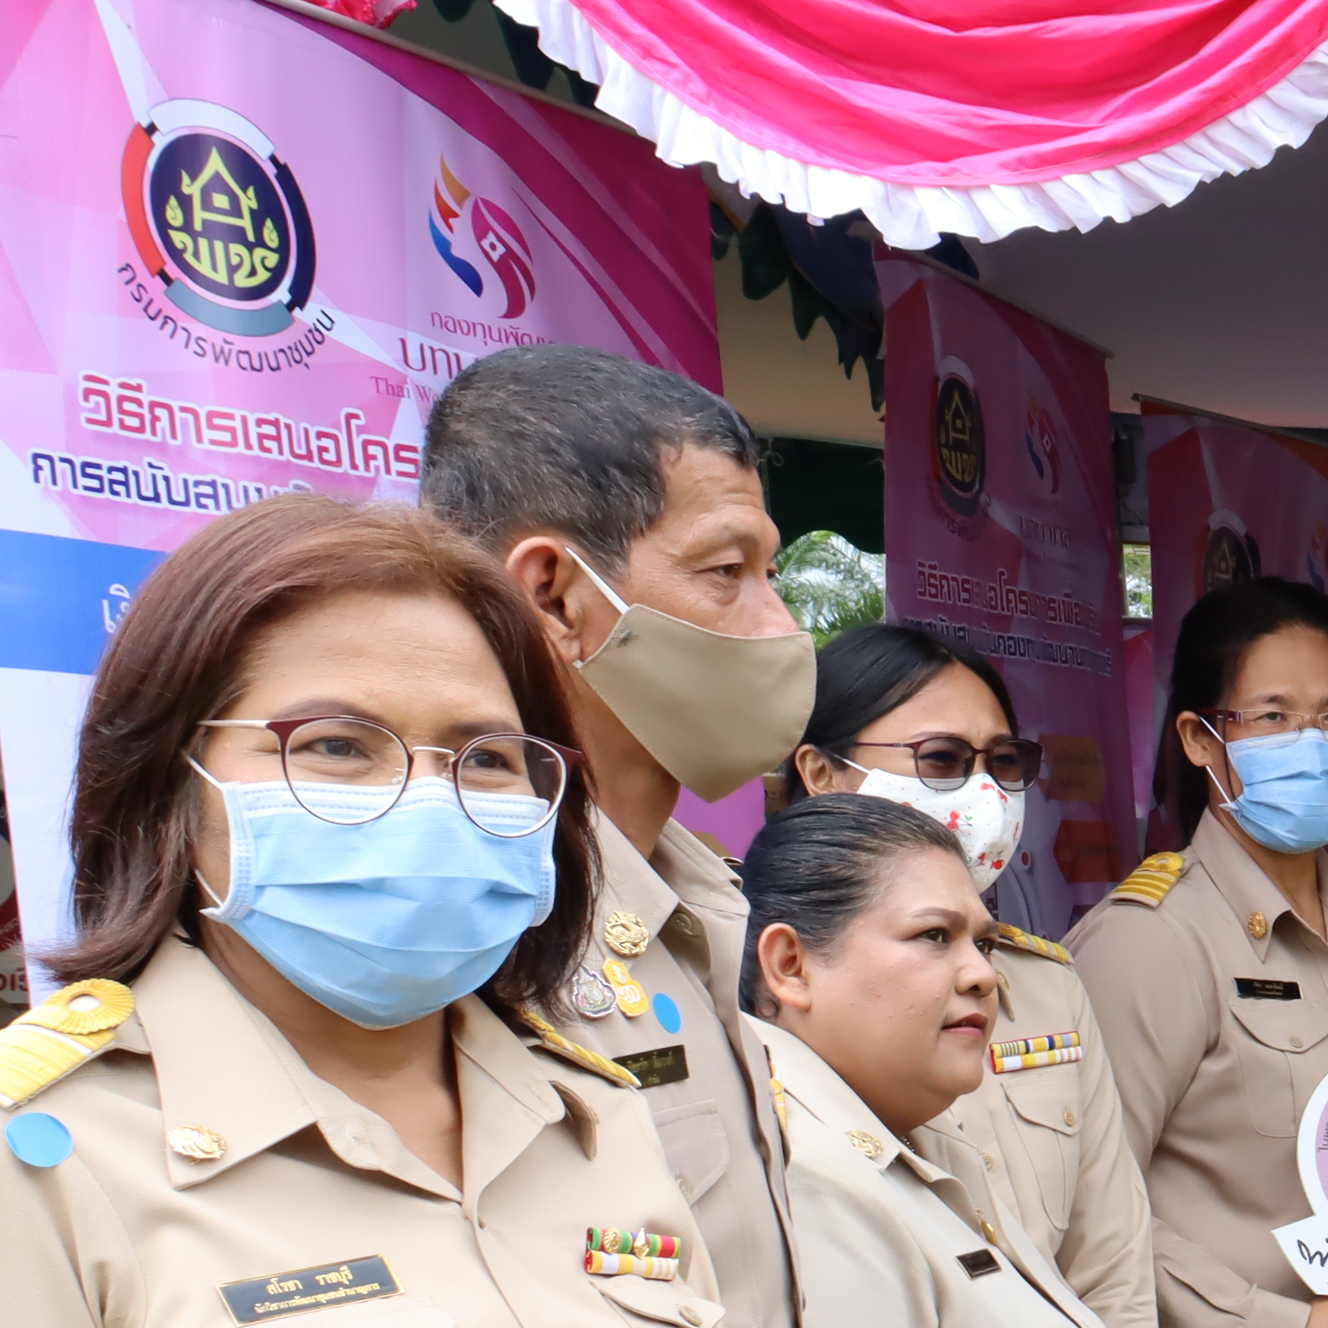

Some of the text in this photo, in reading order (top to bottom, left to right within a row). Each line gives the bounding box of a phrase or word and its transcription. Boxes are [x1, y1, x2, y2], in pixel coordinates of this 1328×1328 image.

[116, 262, 337, 374] กรมการพัฒนาชุมชน
[370, 375, 411, 399] Thai
